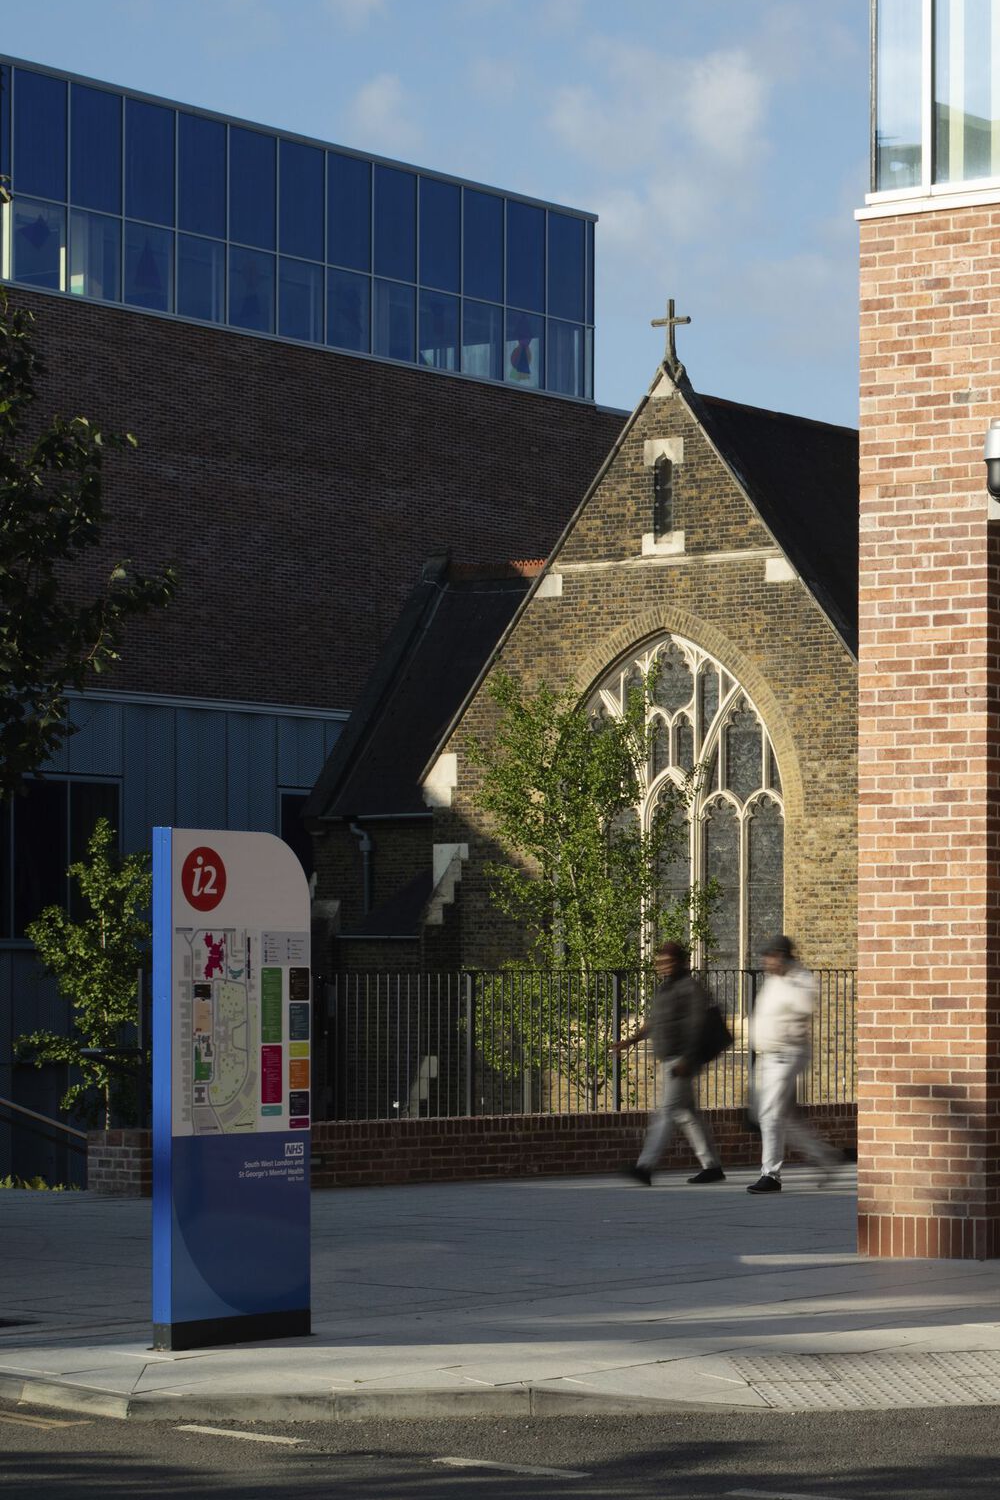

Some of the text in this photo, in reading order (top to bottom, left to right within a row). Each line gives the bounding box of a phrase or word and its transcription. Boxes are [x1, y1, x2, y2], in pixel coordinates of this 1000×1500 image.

[192, 855, 218, 897] i2
[286, 1144, 303, 1154] NHS
[245, 1170, 268, 1179] George's
